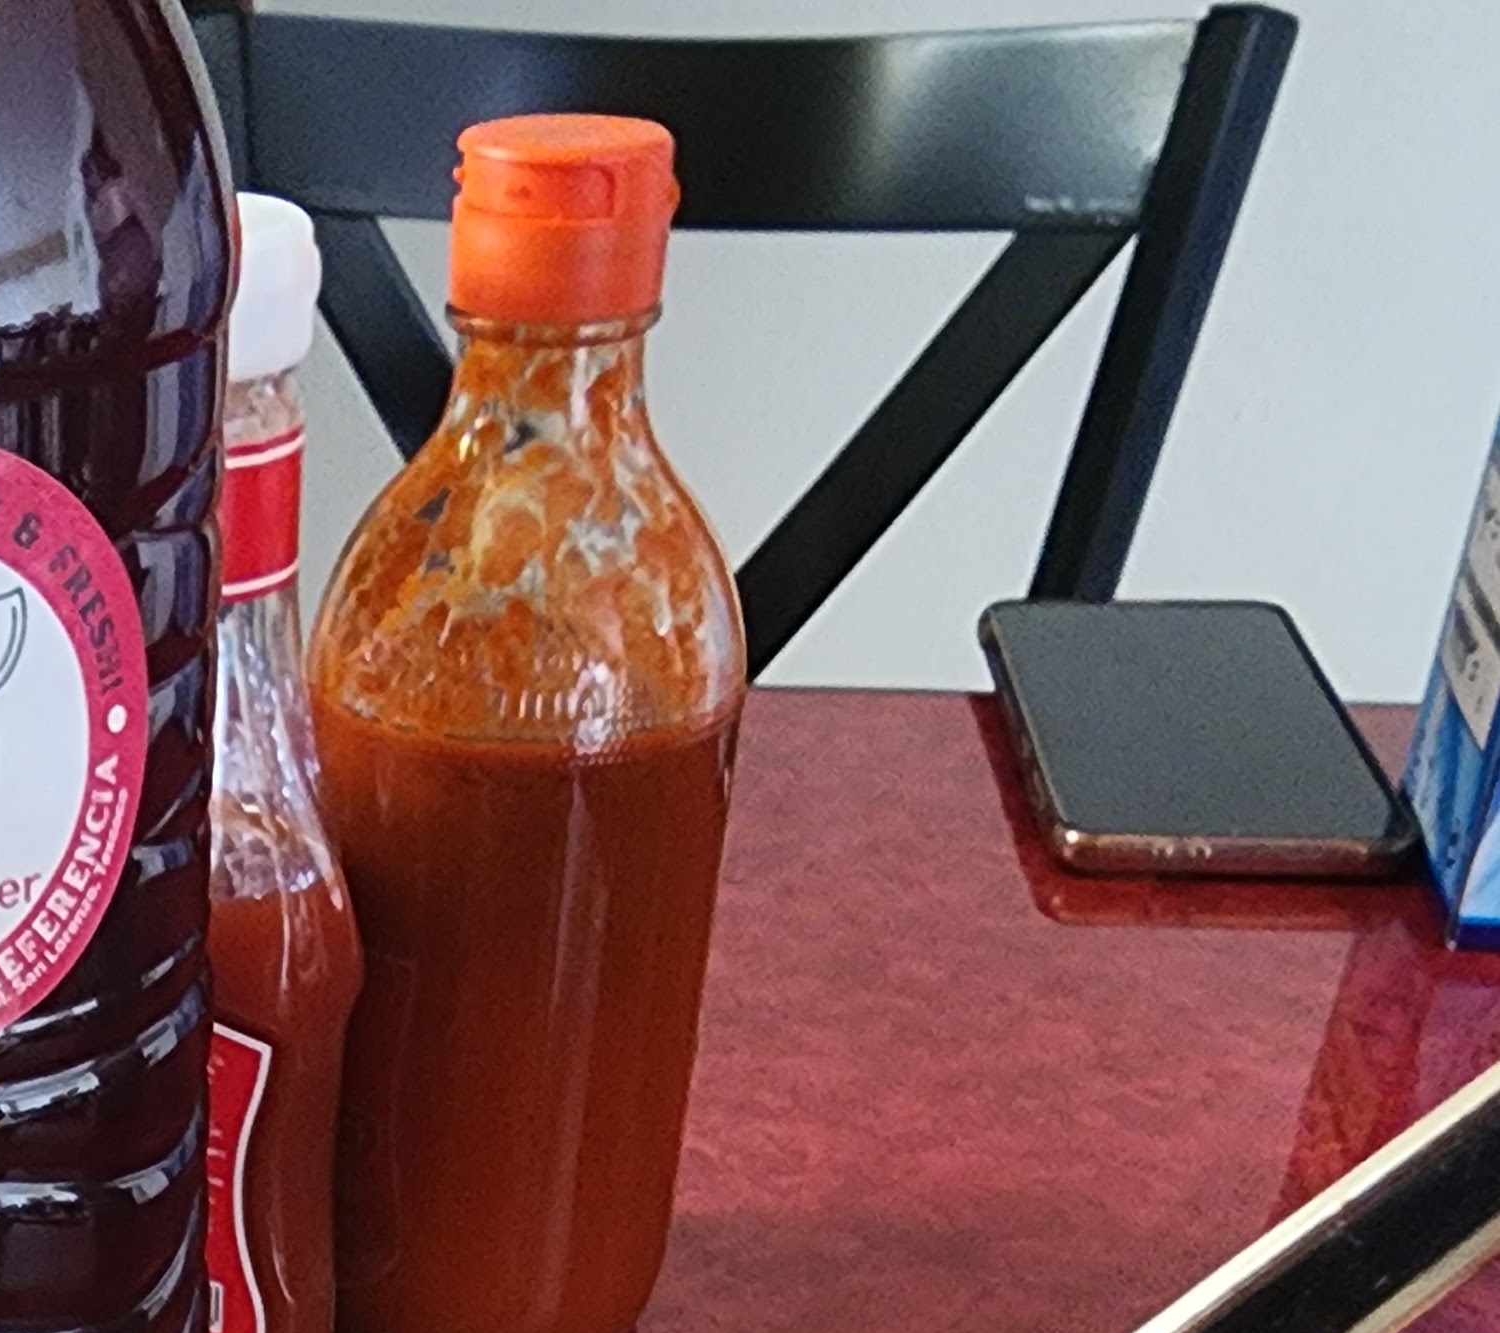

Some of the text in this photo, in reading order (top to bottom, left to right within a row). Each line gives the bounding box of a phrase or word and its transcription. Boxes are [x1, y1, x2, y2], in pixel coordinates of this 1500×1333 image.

[12, 511, 42, 549] &
[49, 545, 123, 694] FRESH!
[12, 961, 47, 996] San
